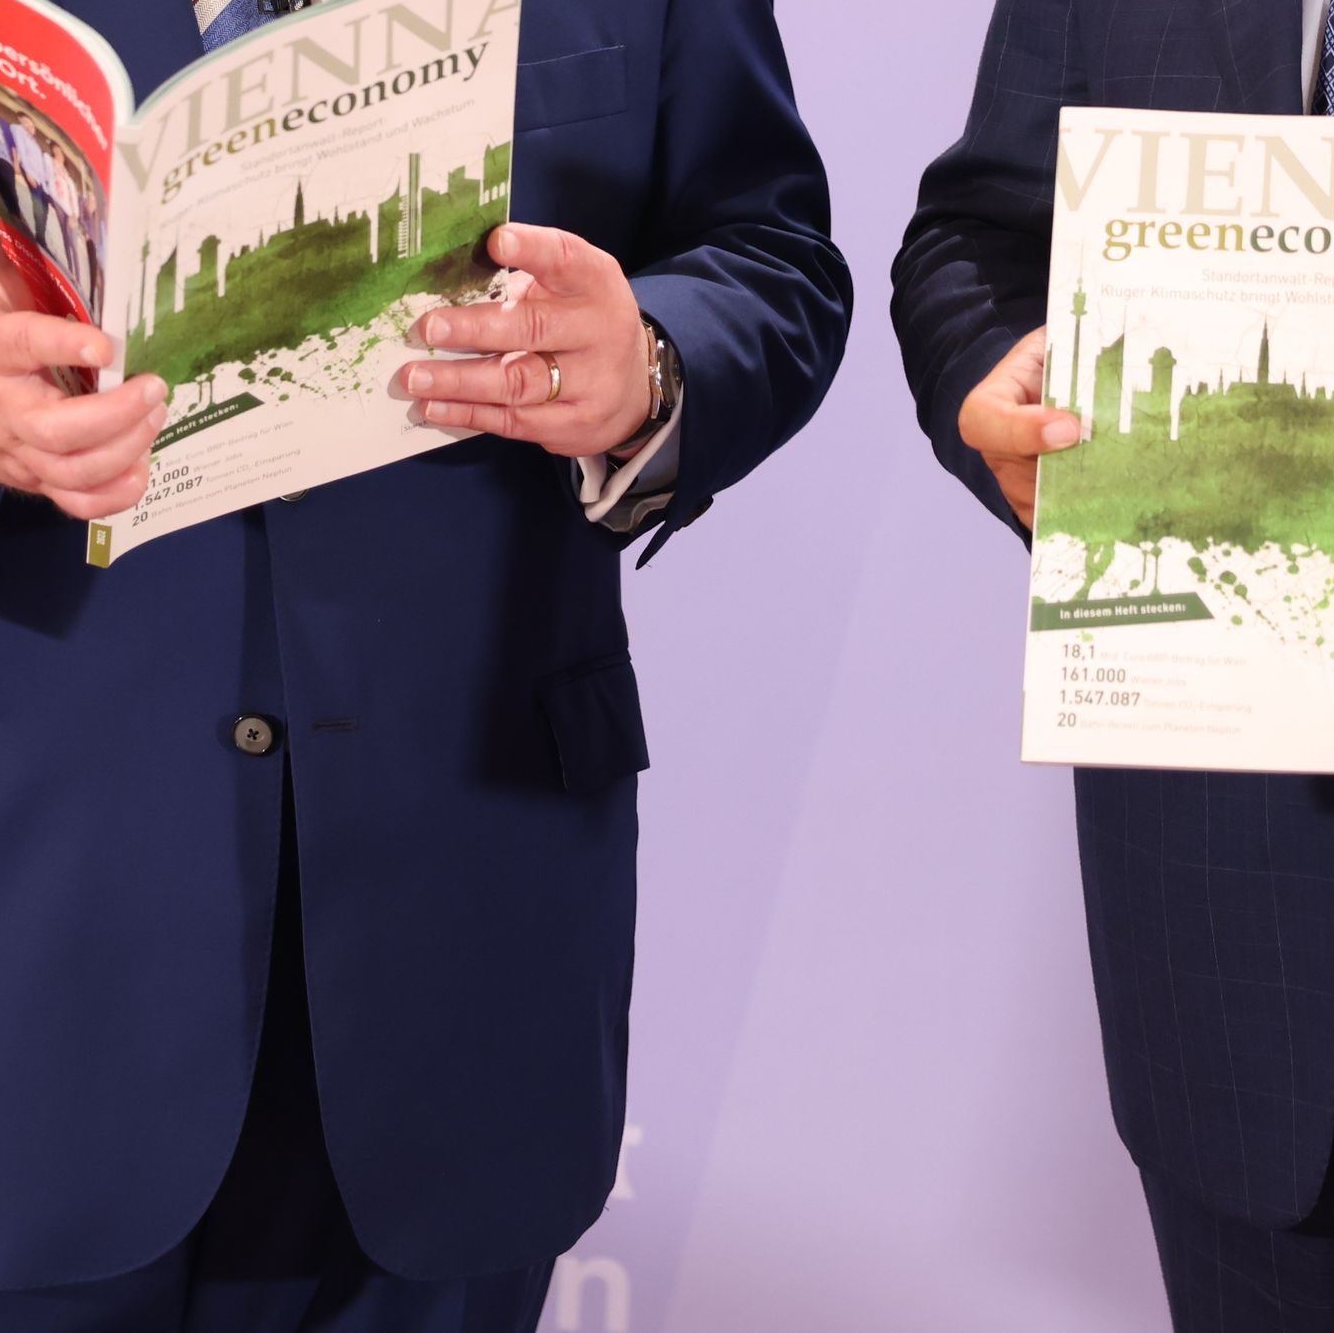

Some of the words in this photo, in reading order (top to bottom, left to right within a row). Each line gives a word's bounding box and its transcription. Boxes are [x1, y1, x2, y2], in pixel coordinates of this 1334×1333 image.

[161, 41, 490, 204] greeneconomy
[1100, 283, 1145, 300] Kluger
[1150, 284, 1236, 302] Klimaschutz
[1240, 290, 1281, 306] bringt
[146, 465, 190, 491] 1.000
[134, 476, 203, 511] 1.547.087
[132, 511, 149, 528] 20
[1059, 608, 1072, 620] In
[1072, 607, 1112, 619] diesem
[1114, 603, 1138, 616] Heft
[1140, 601, 1187, 615] stecken:
[1061, 643, 1096, 662] 18,1
[1060, 666, 1127, 684] 161.000
[1059, 688, 1142, 708] 1.547.087
[1056, 711, 1077, 729] 20
